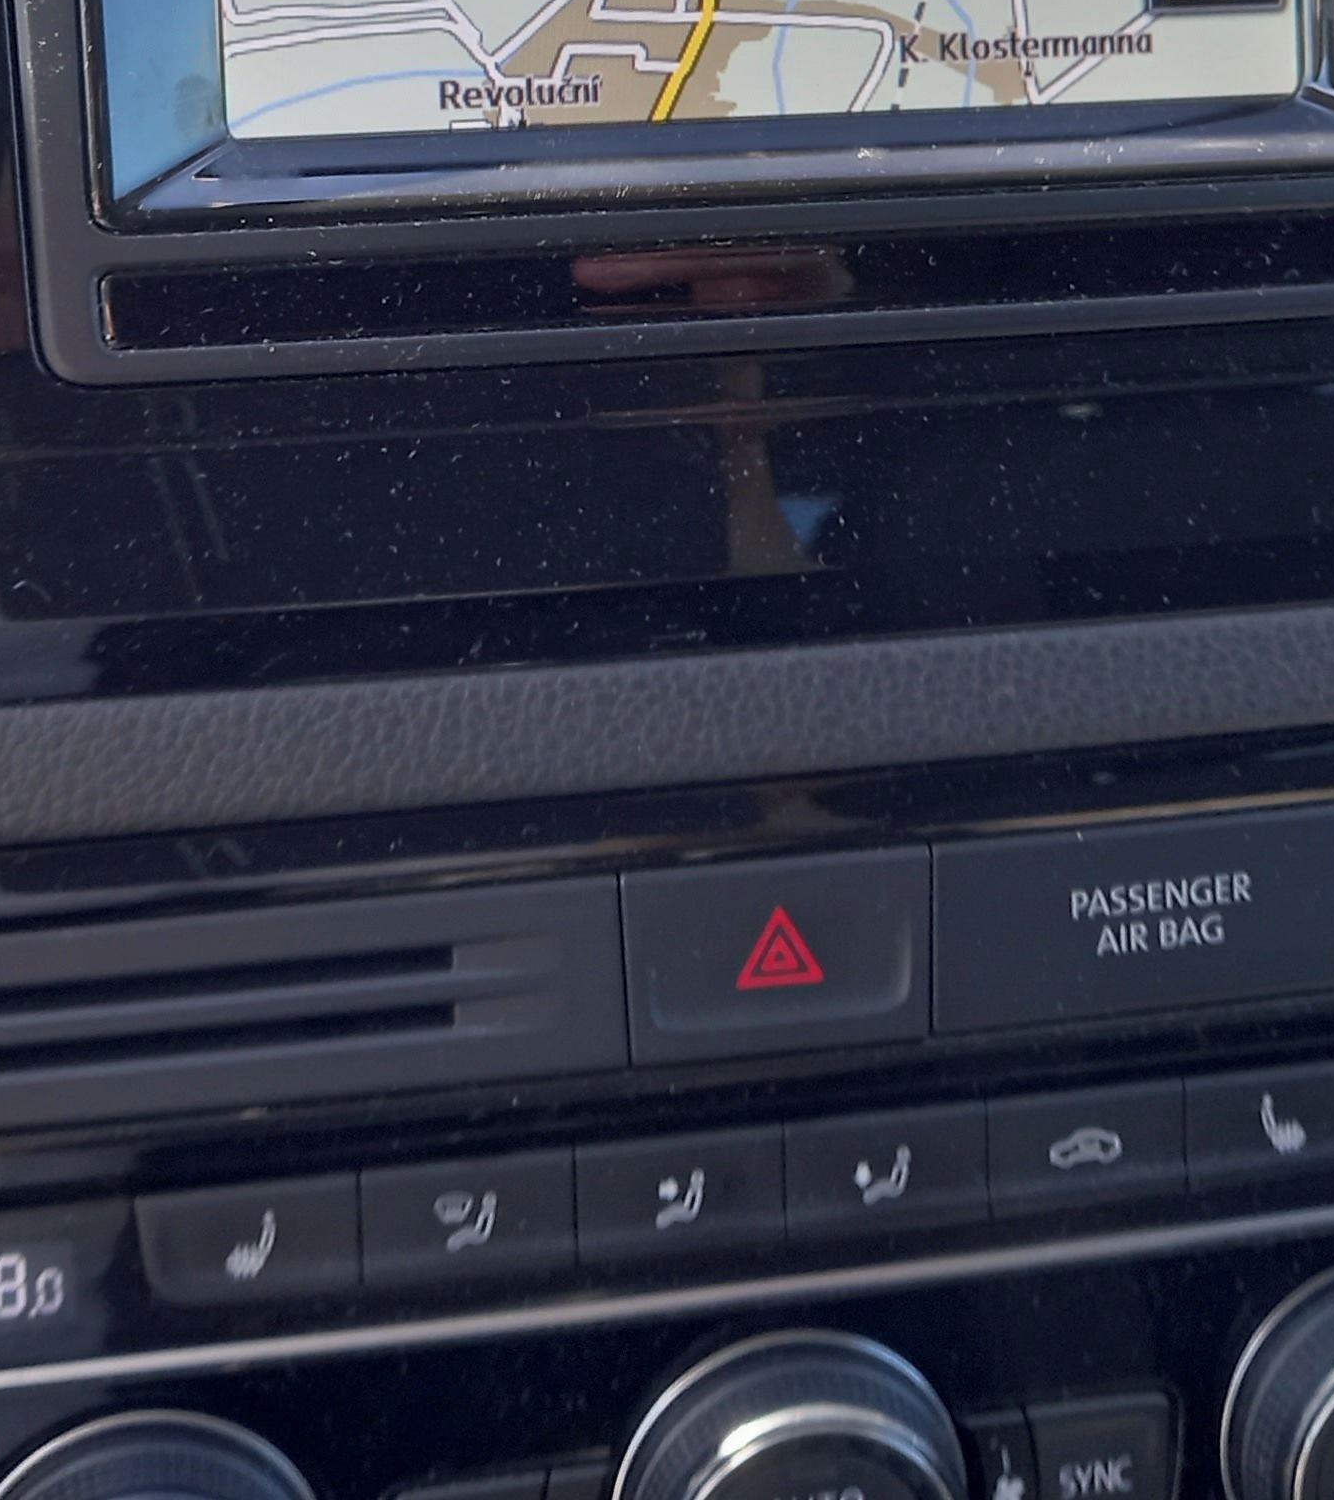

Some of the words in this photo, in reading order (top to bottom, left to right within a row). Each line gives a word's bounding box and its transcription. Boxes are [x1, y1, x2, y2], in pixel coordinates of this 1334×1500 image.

[899, 35, 929, 63] K.
[939, 29, 1153, 61] Klostermanna
[438, 72, 603, 110] Revoluční
[1069, 871, 1253, 920] PASSENGER
[1096, 922, 1149, 957] AIR
[1157, 913, 1226, 950] BAG
[1058, 1454, 1133, 1500] SYNC
